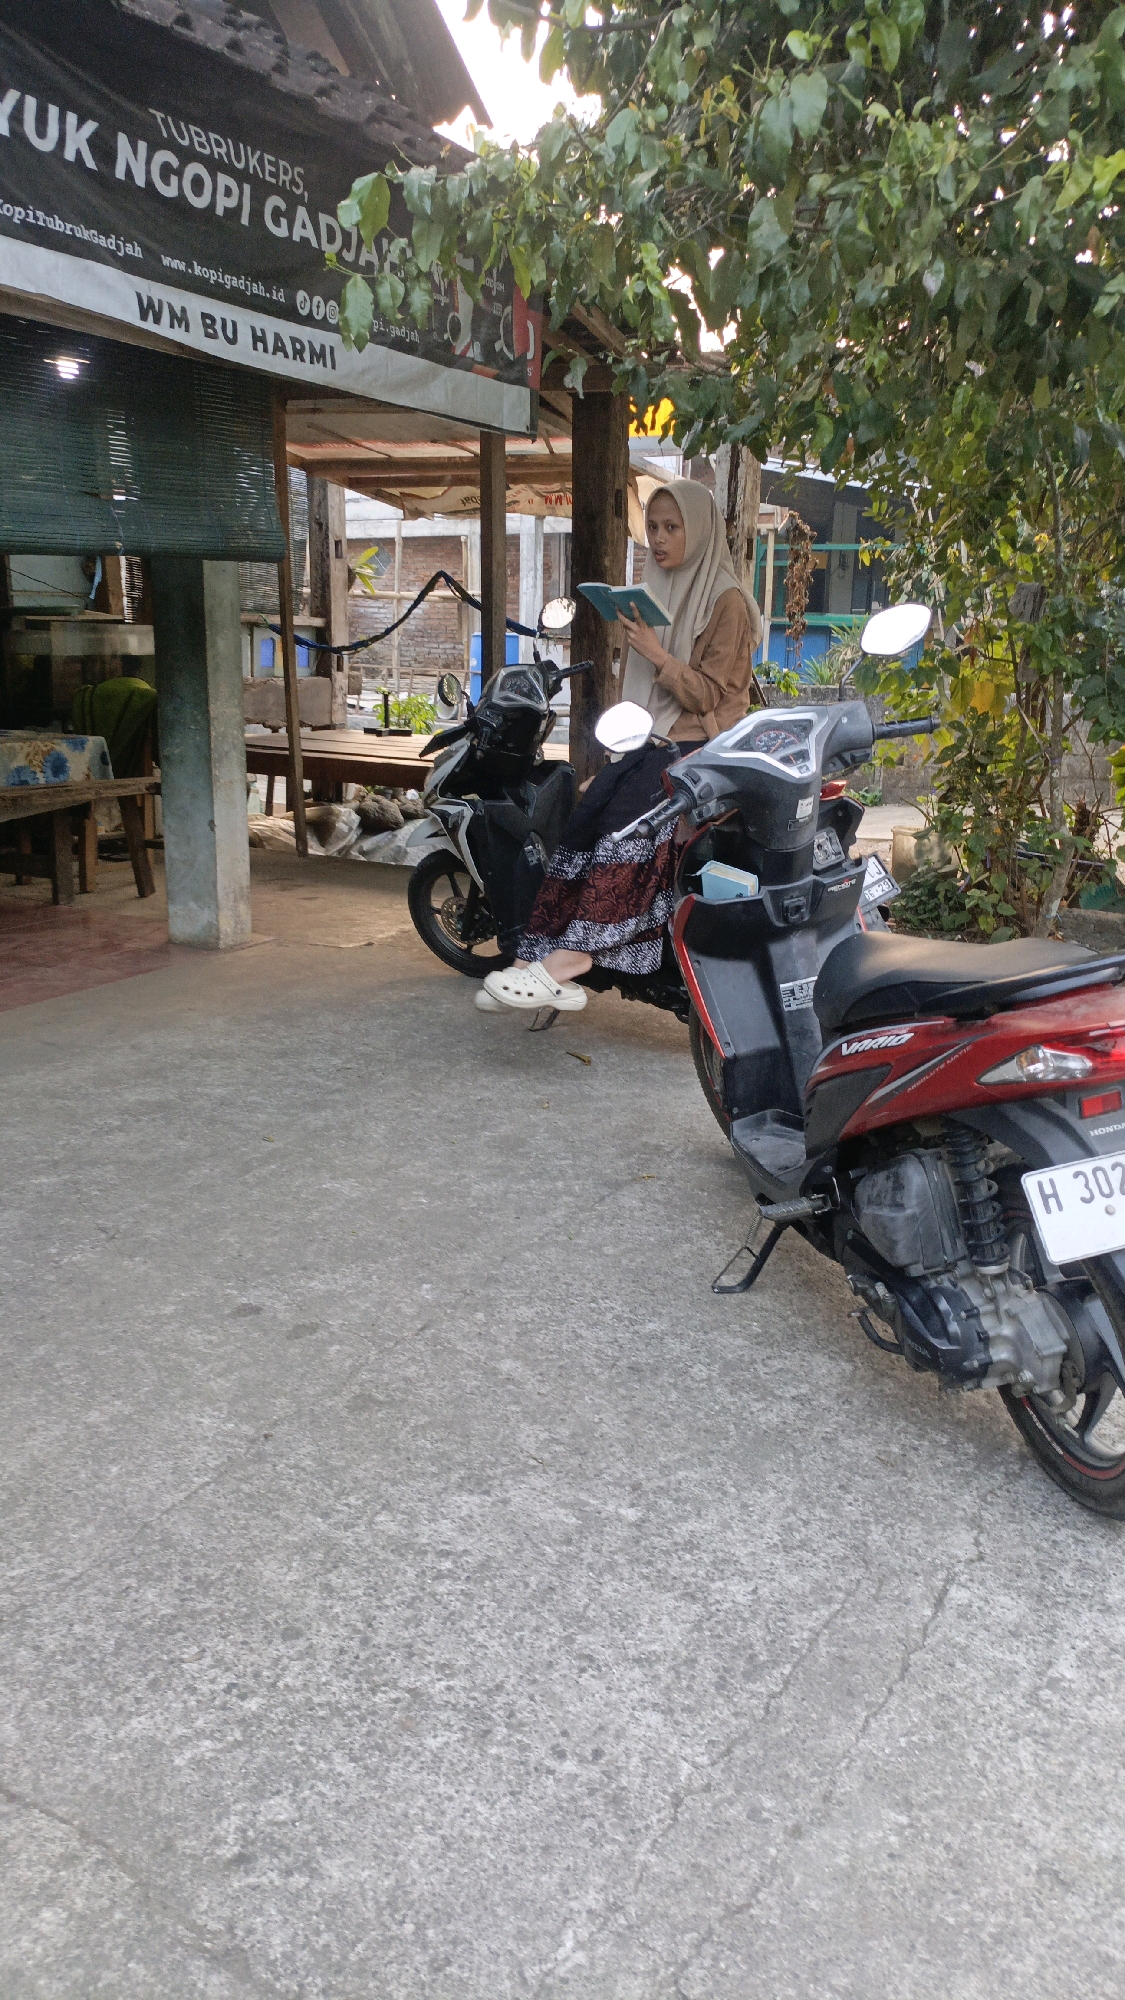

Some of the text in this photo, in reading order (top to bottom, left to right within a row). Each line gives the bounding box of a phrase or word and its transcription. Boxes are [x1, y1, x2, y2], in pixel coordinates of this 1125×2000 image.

[0, 88, 100, 171] YUK
[115, 131, 251, 227] NGOPI
[147, 108, 309, 203] TUBRUKERS,
[160, 254, 286, 304] www.kopigadjah.id
[135, 290, 337, 371] WM BU HARMI
[841, 1032, 914, 1057] VARIO
[1037, 1160, 1125, 1215] H 302
